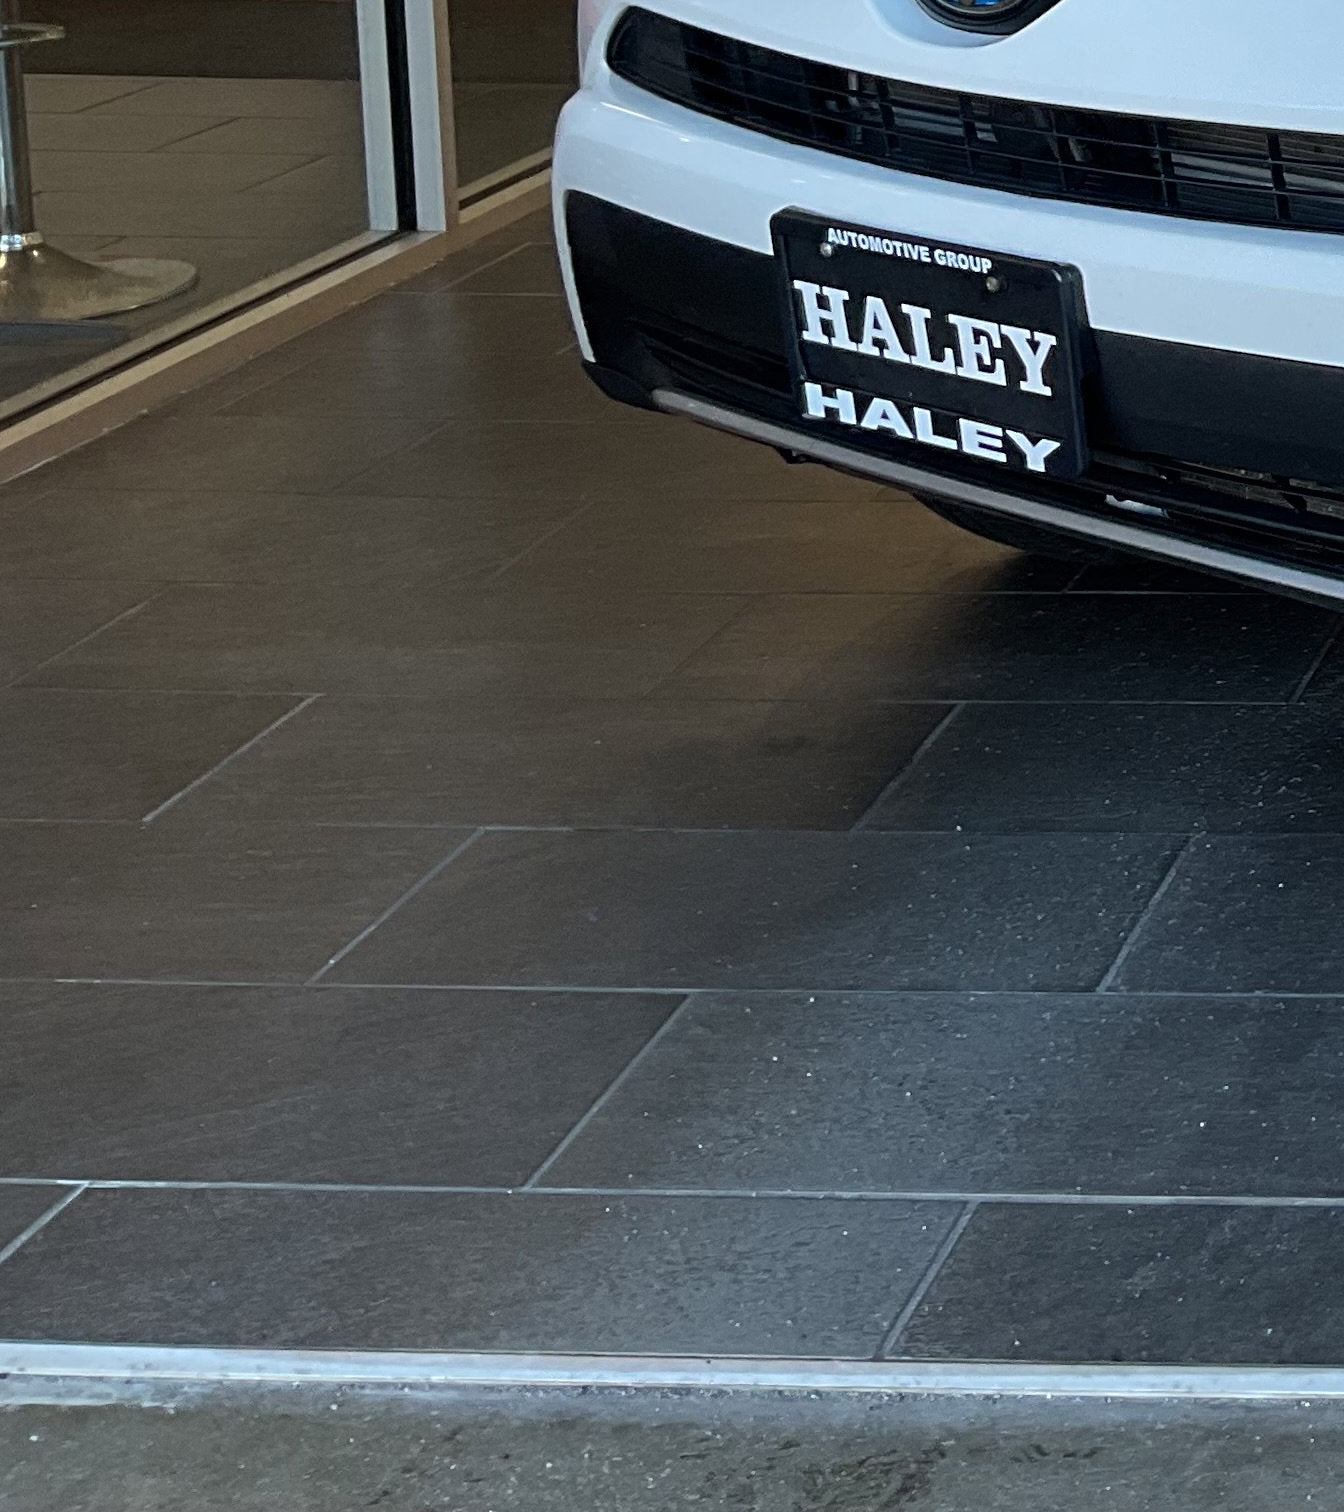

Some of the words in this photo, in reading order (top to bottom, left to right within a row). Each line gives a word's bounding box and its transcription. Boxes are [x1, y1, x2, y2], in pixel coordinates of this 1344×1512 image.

[827, 227, 932, 264] AUTOMOTIVE
[933, 248, 993, 274] GROUP
[792, 279, 1057, 397] HALEY
[803, 381, 1061, 473] HALEY
